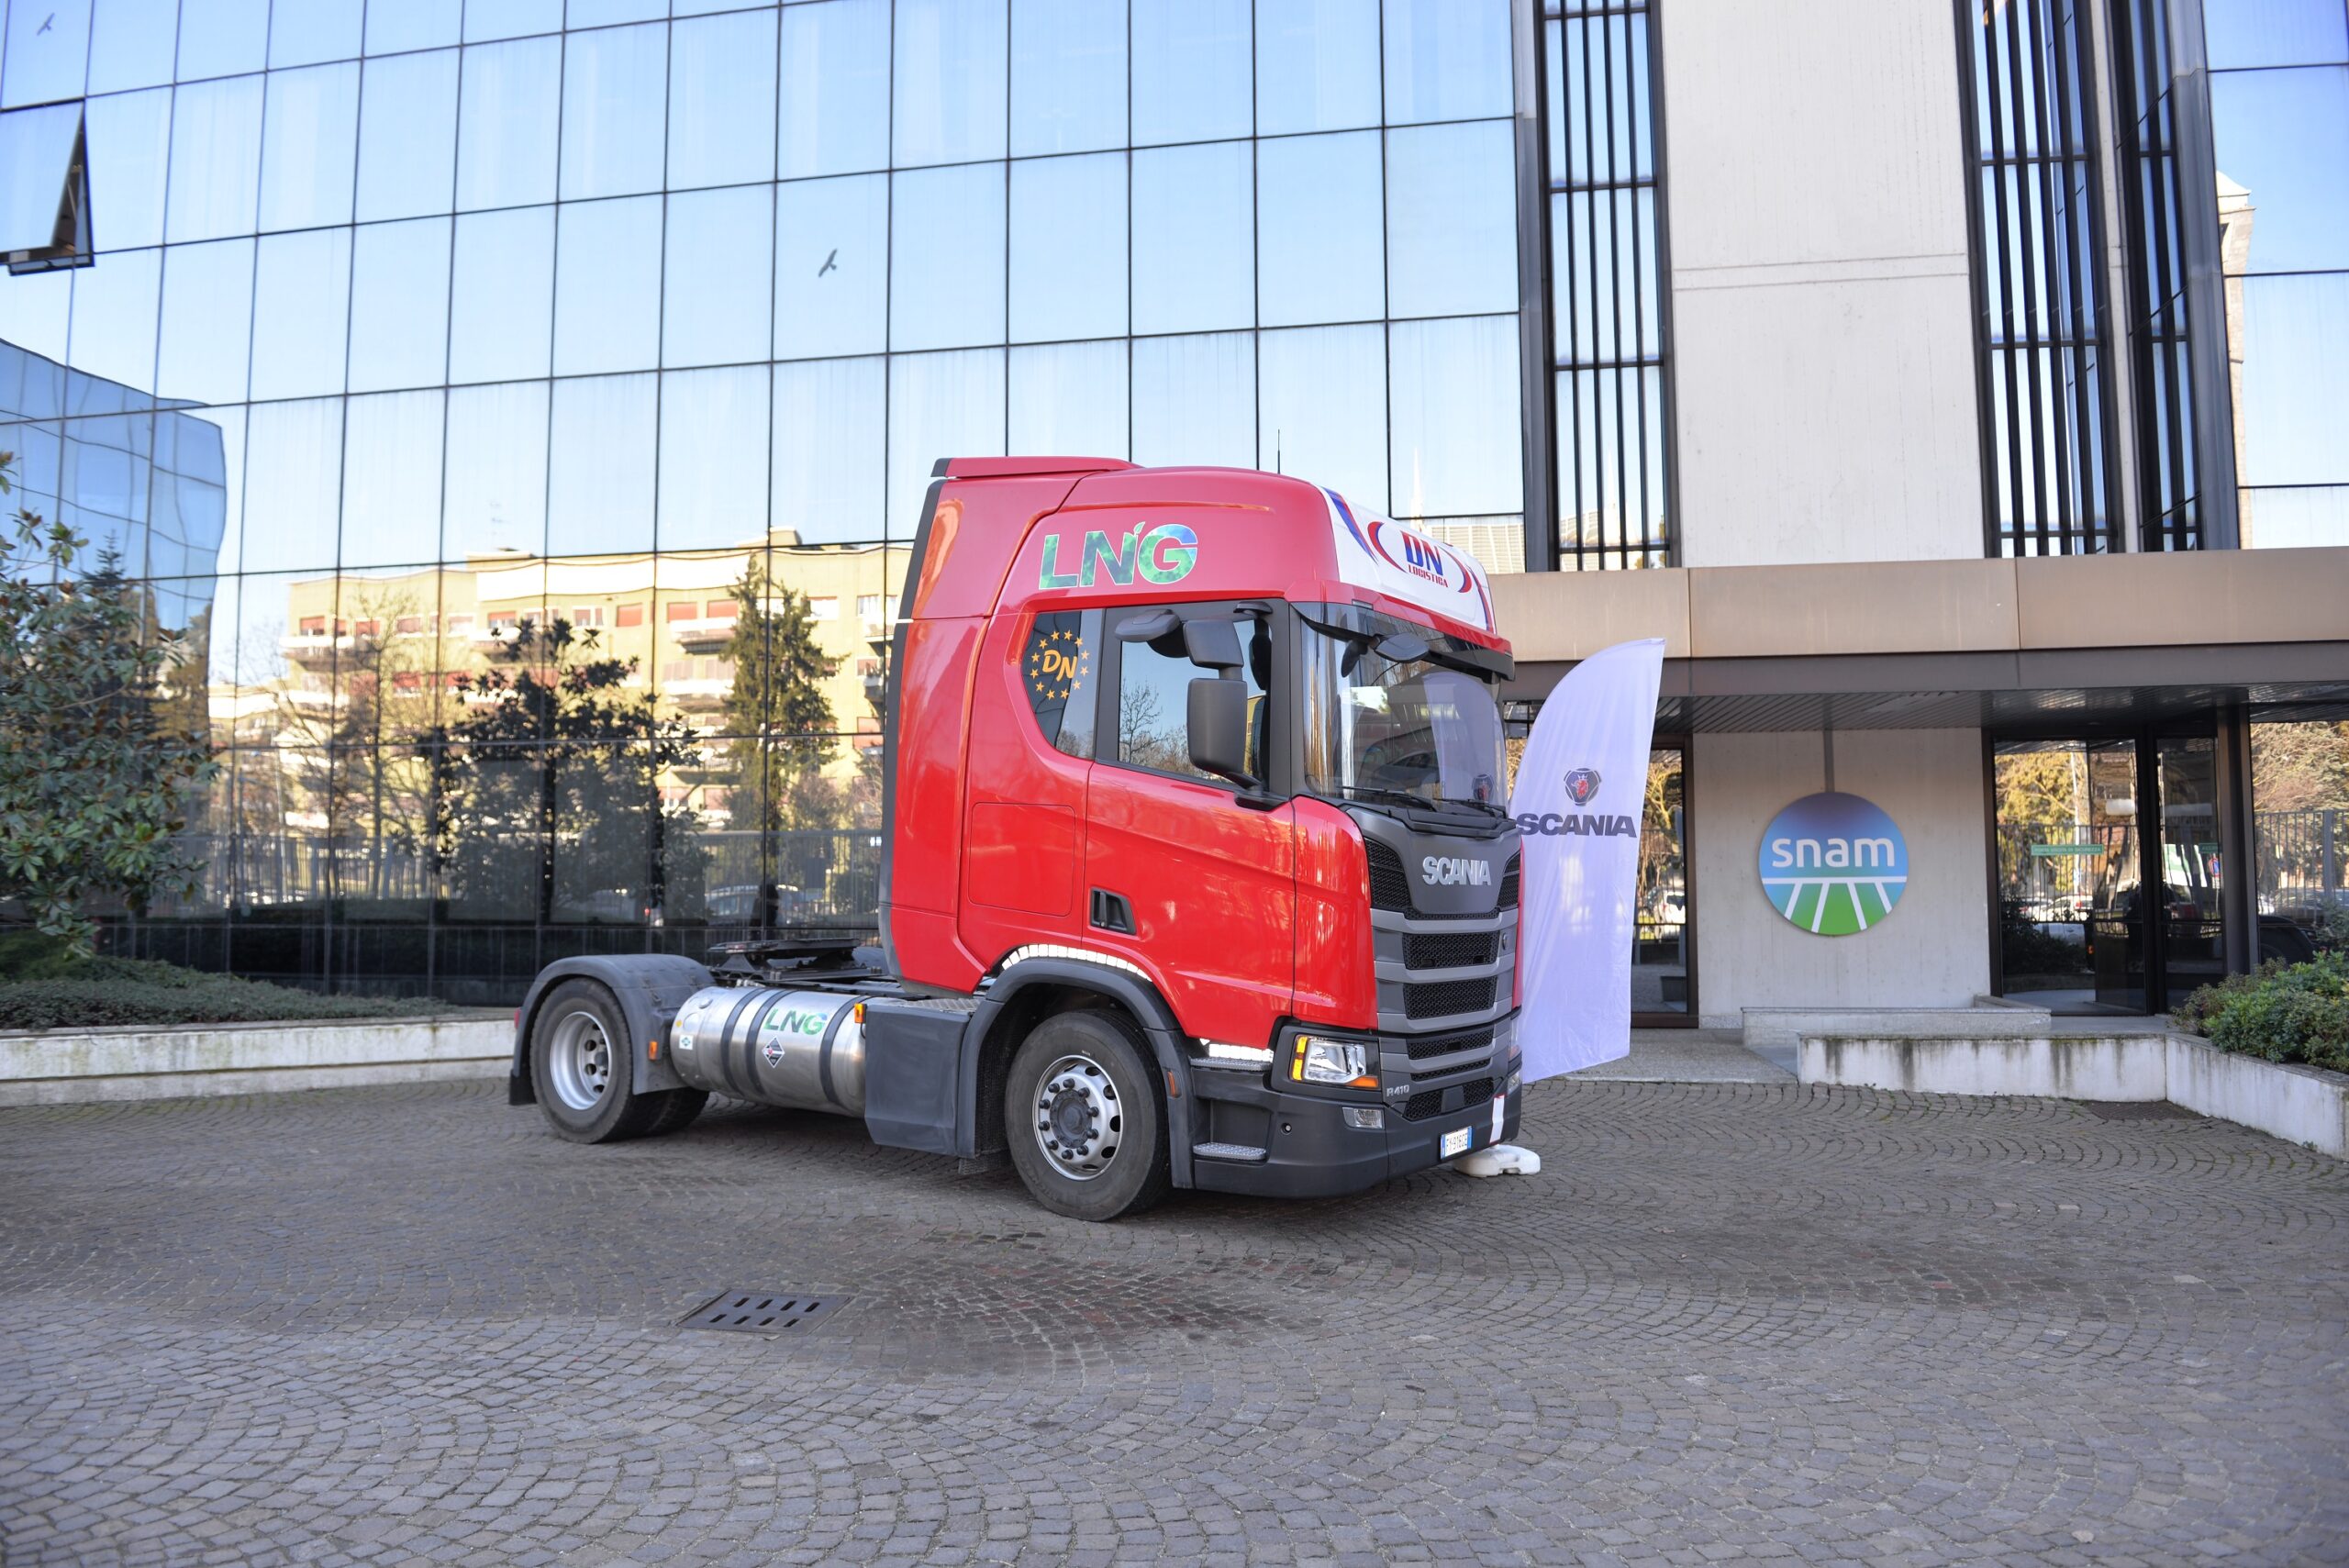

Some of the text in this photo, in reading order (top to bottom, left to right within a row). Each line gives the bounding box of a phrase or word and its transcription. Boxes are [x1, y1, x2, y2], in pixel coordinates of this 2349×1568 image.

[1039, 521, 1198, 590] LNG
[1400, 530, 1443, 576] DN
[1408, 563, 1449, 588] LOGISTICA
[1042, 649, 1078, 682] DN
[1516, 813, 1637, 838] SCANIA
[1772, 838, 1895, 868] snam
[1422, 856, 1492, 886] SCANIA
[763, 1008, 828, 1036] LNG
